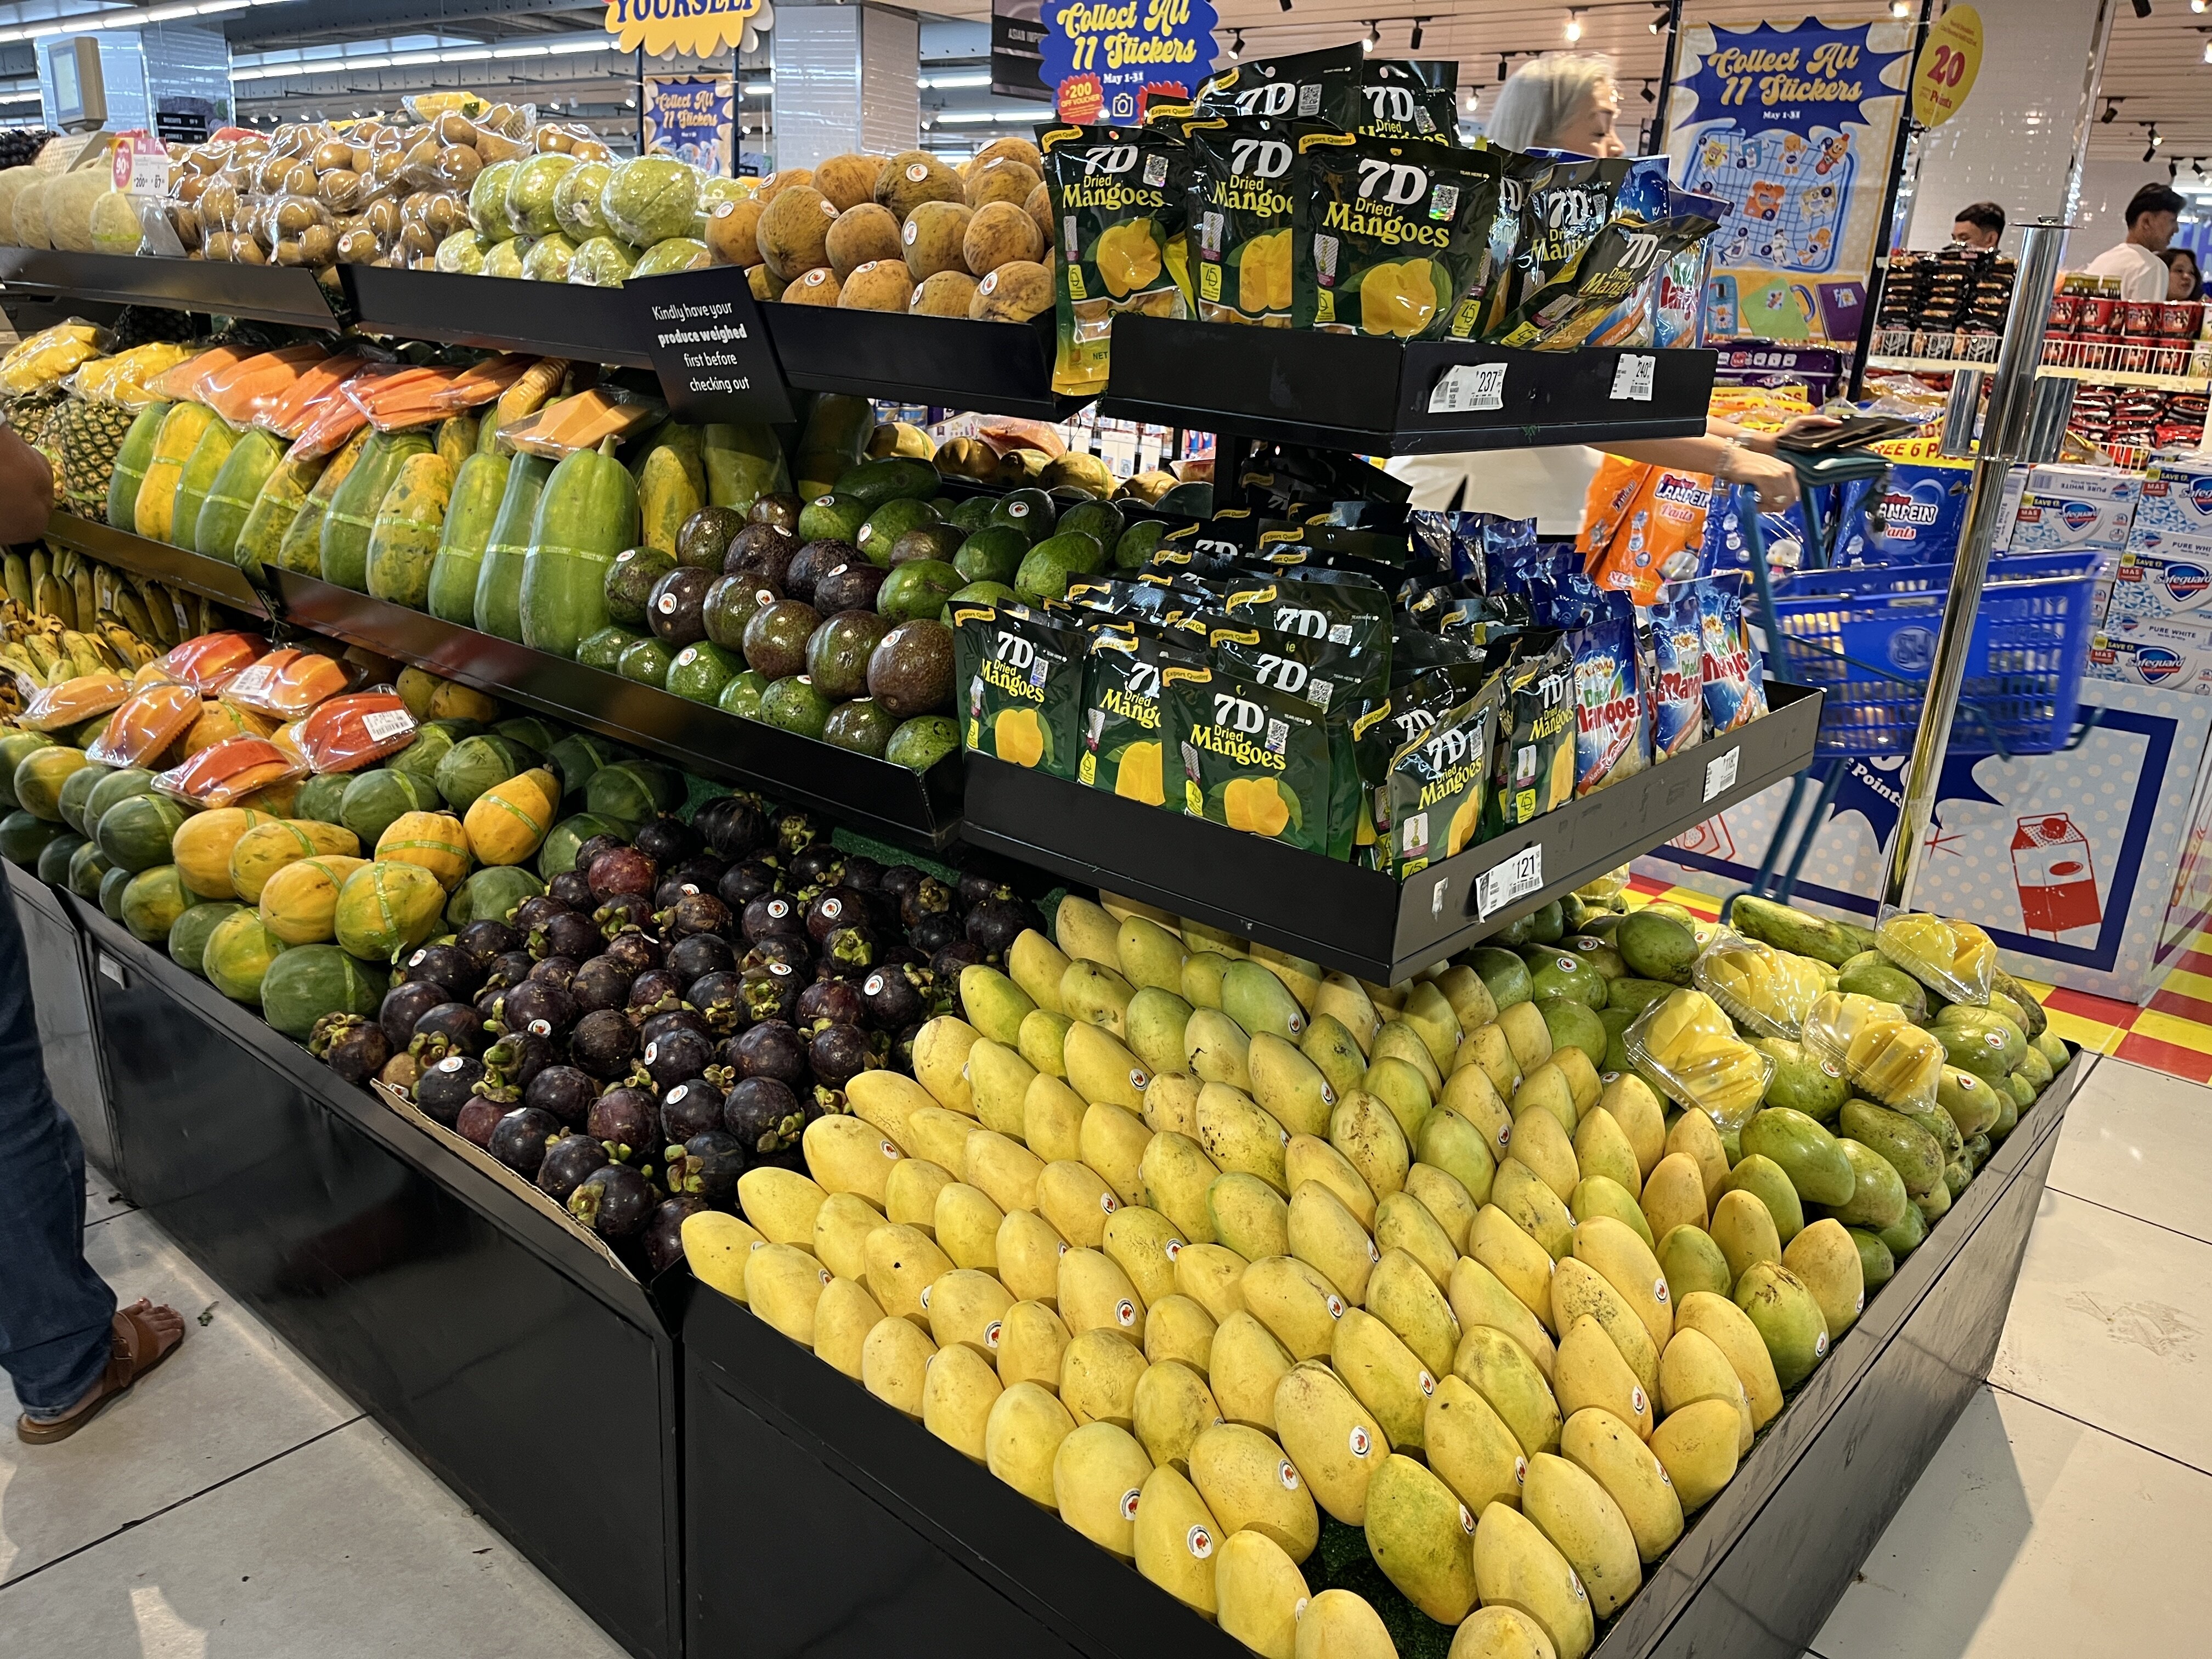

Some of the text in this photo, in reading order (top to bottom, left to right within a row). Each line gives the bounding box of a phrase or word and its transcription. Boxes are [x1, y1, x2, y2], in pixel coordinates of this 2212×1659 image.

[1057, 0, 1190, 38] Collect All
[1073, 32, 1197, 70] 11 Stickers
[1707, 42, 1860, 78] Collect All
[1927, 44, 1965, 87] 20
[1103, 72, 1144, 84] May 1-31
[1236, 83, 1296, 115] 7D
[1720, 73, 1862, 106] 11 Stickers
[655, 91, 714, 112] Collect All
[1365, 86, 1414, 121] 7D
[663, 109, 718, 129] 11 Stickers
[1376, 119, 1402, 133] Dried
[1045, 133, 1062, 143] Export
[1303, 136, 1352, 144] Export Quality
[1085, 145, 1138, 175] 7D
[1231, 139, 1294, 178] 7D
[1083, 174, 1113, 188] Dried
[1229, 174, 1264, 191] Dried
[1358, 158, 1427, 205] 7D
[1063, 183, 1164, 211] Mangoes
[1212, 180, 1293, 218] Mango
[1355, 197, 1394, 217] Dried
[1548, 190, 1589, 228] 7D
[1322, 201, 1451, 249] Mangoes
[1617, 233, 1658, 269] 7D
[1608, 267, 1632, 282] Dried
[652, 302, 732, 322] Kindly have your
[658, 323, 748, 348] produce weighed
[684, 351, 738, 368] first before
[1093, 352, 1108, 360] NET
[690, 376, 750, 393] checking out
[1477, 371, 1498, 393] 237
[1866, 443, 1907, 456] REE
[1910, 443, 1922, 457] 6
[2179, 488, 2212, 499] Safeg
[1662, 503, 1694, 522] Pants
[1865, 503, 1937, 522] AMPEIN
[1263, 532, 1302, 541] Export Quality
[2153, 572, 2212, 585] Safeguard
[1230, 594, 1250, 604] Export
[1275, 607, 1328, 639] 7D
[2149, 625, 2170, 634] PURE
[2171, 629, 2196, 639] WHITE
[1235, 634, 1256, 642] Quality
[997, 630, 1034, 669] 7D
[994, 659, 1017, 676] Dried
[1256, 653, 1308, 693] 7D
[2125, 656, 2186, 669] Safeguard
[980, 658, 1045, 703] Mangoes
[1187, 673, 1209, 681] Quality
[1124, 689, 1153, 706] Dried
[1538, 674, 1564, 709] 7D
[1099, 688, 1162, 729] Mang
[1214, 692, 1265, 734] 7D
[1544, 704, 1558, 720] Dried
[1214, 724, 1244, 742] Dried
[1356, 714, 1373, 730] Export
[1395, 709, 1436, 742] 7D
[1528, 706, 1574, 742] Mangoes
[1190, 724, 1286, 770] Mangoes
[1426, 727, 1467, 771] 7D
[1418, 757, 1482, 811] Mangoes
[1436, 763, 1457, 785] Dried
[1516, 854, 1534, 879] 121
